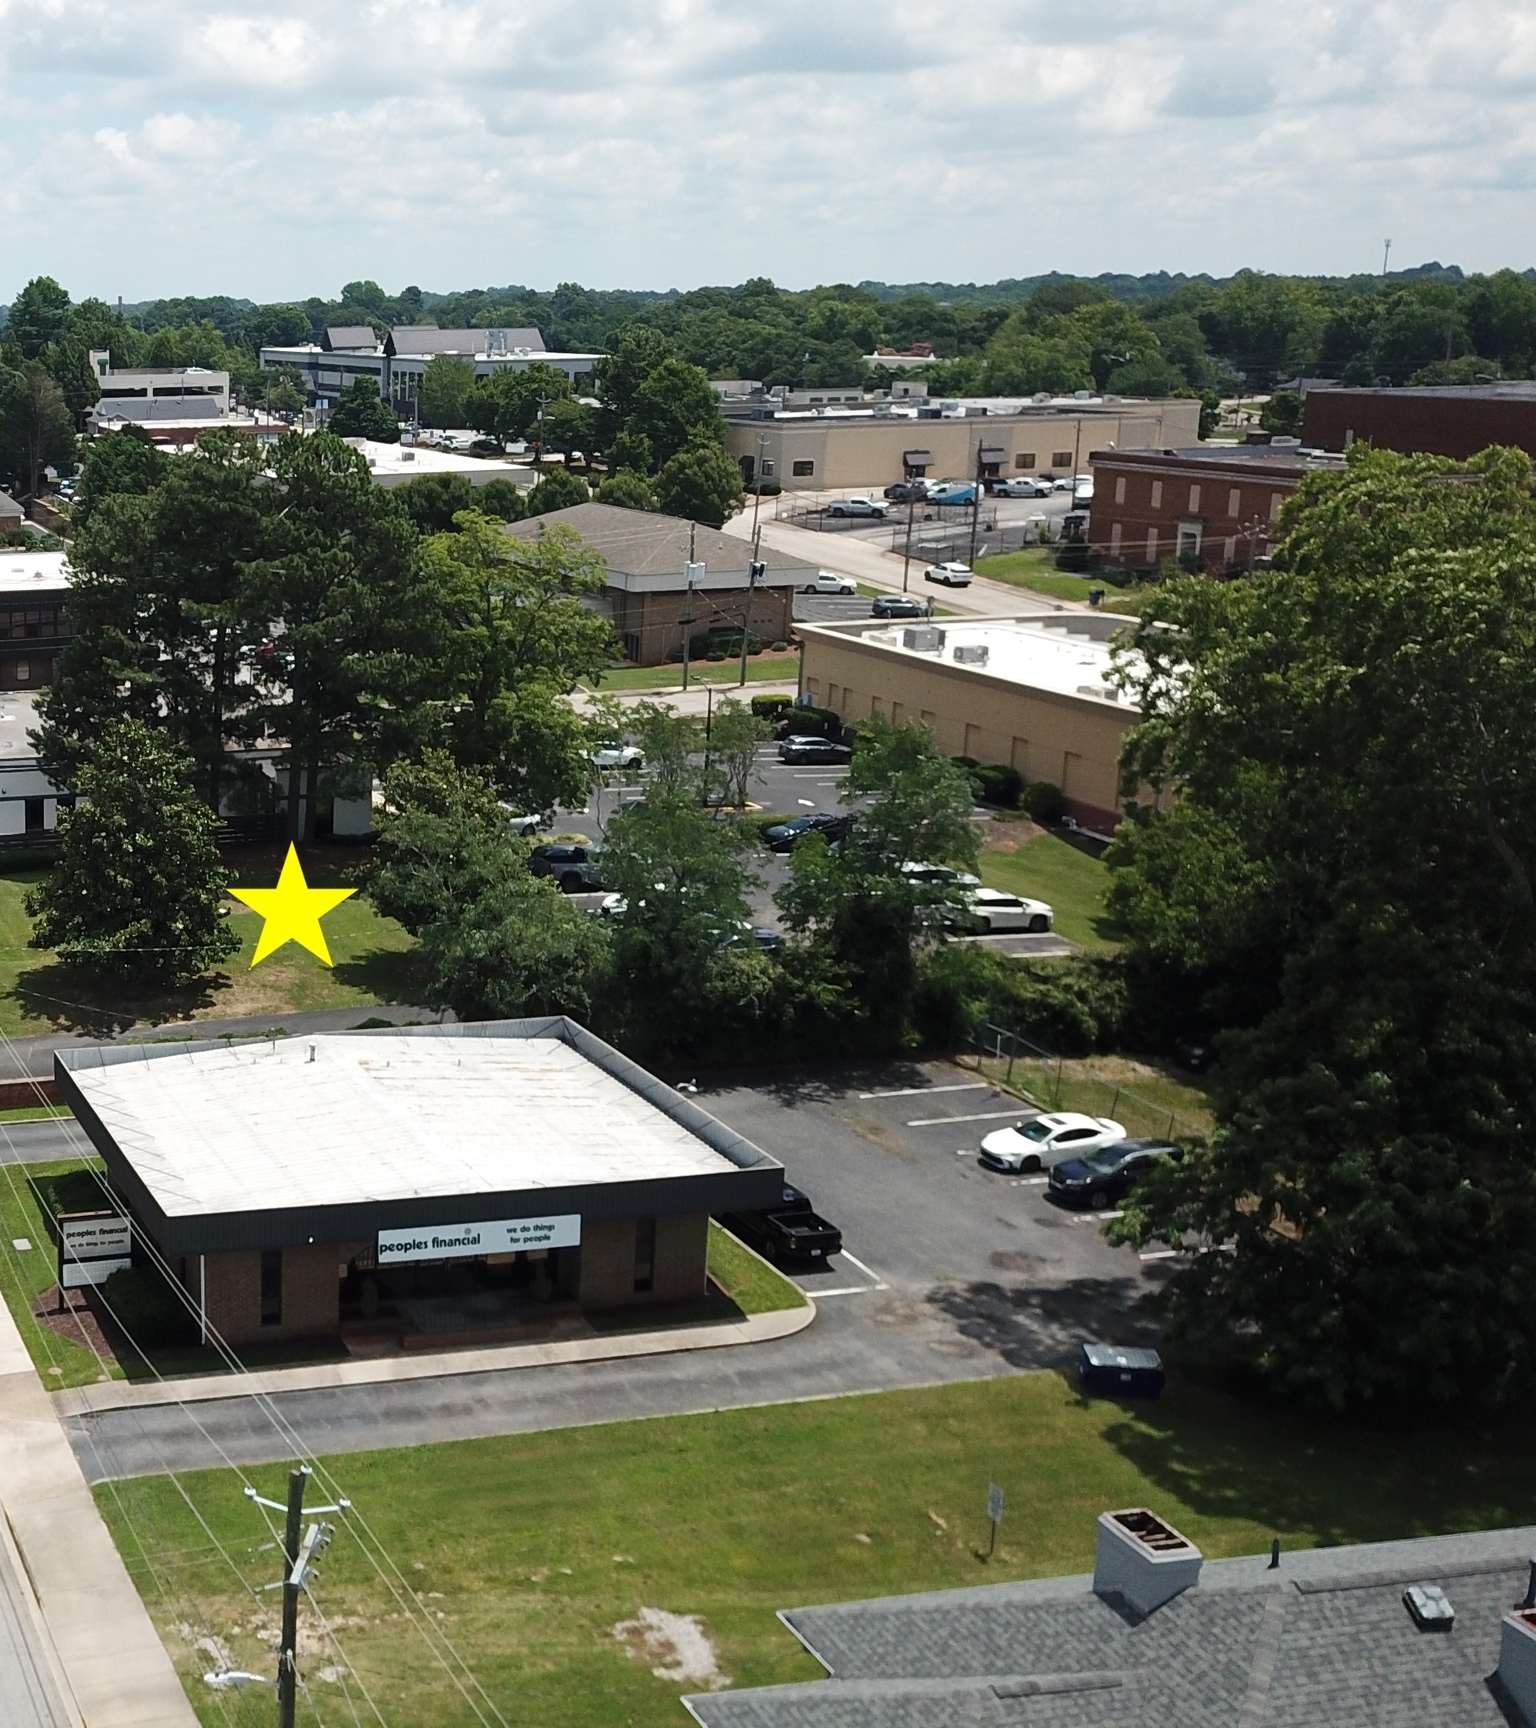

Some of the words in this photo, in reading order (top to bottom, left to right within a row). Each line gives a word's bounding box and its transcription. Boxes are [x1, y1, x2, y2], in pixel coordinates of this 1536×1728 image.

[66, 1229, 97, 1240] peoples
[99, 1225, 128, 1235] financial
[506, 1226, 517, 1234] we
[519, 1224, 531, 1233] do
[533, 1223, 555, 1233] things
[379, 1238, 428, 1255] peoples
[431, 1231, 481, 1249] financial
[509, 1236, 521, 1244] for
[523, 1233, 551, 1245] people
